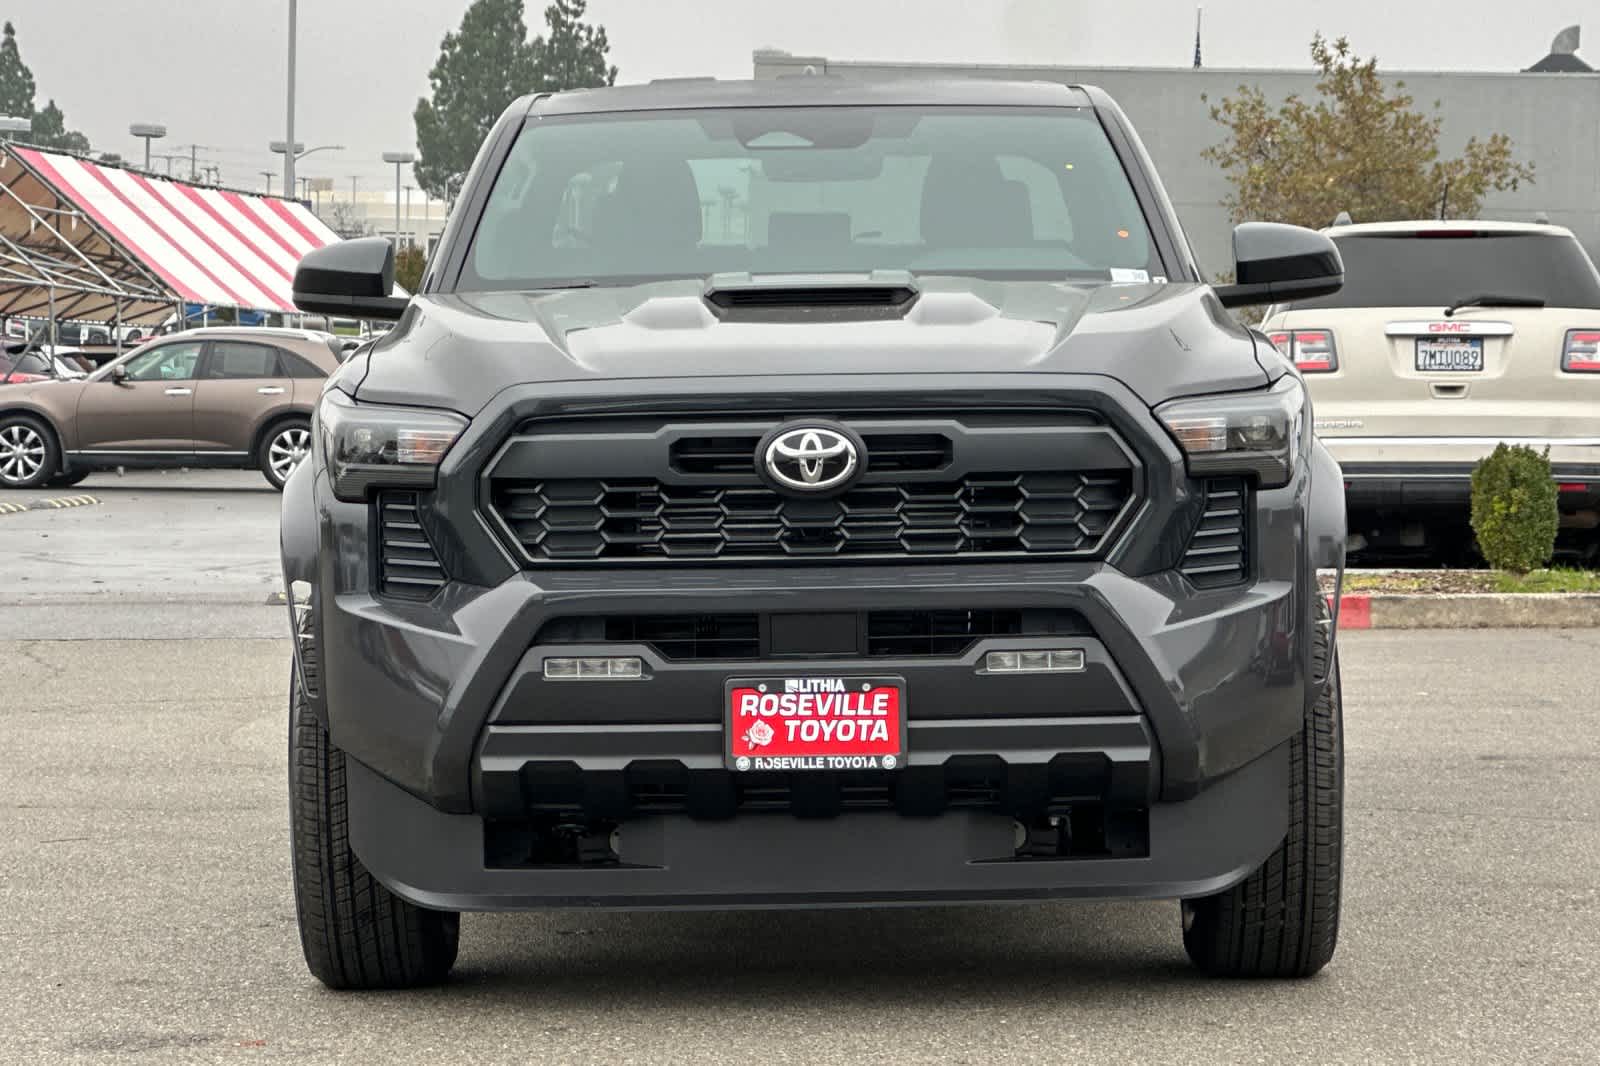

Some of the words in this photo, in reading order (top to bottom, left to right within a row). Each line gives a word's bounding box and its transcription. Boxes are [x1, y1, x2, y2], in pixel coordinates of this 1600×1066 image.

[1428, 323, 1471, 332] GMC
[799, 680, 845, 692] LITHIA
[740, 694, 889, 717] ROSEVILLE
[785, 720, 889, 742] TOYOTA
[755, 757, 825, 769] ROSEVILLE
